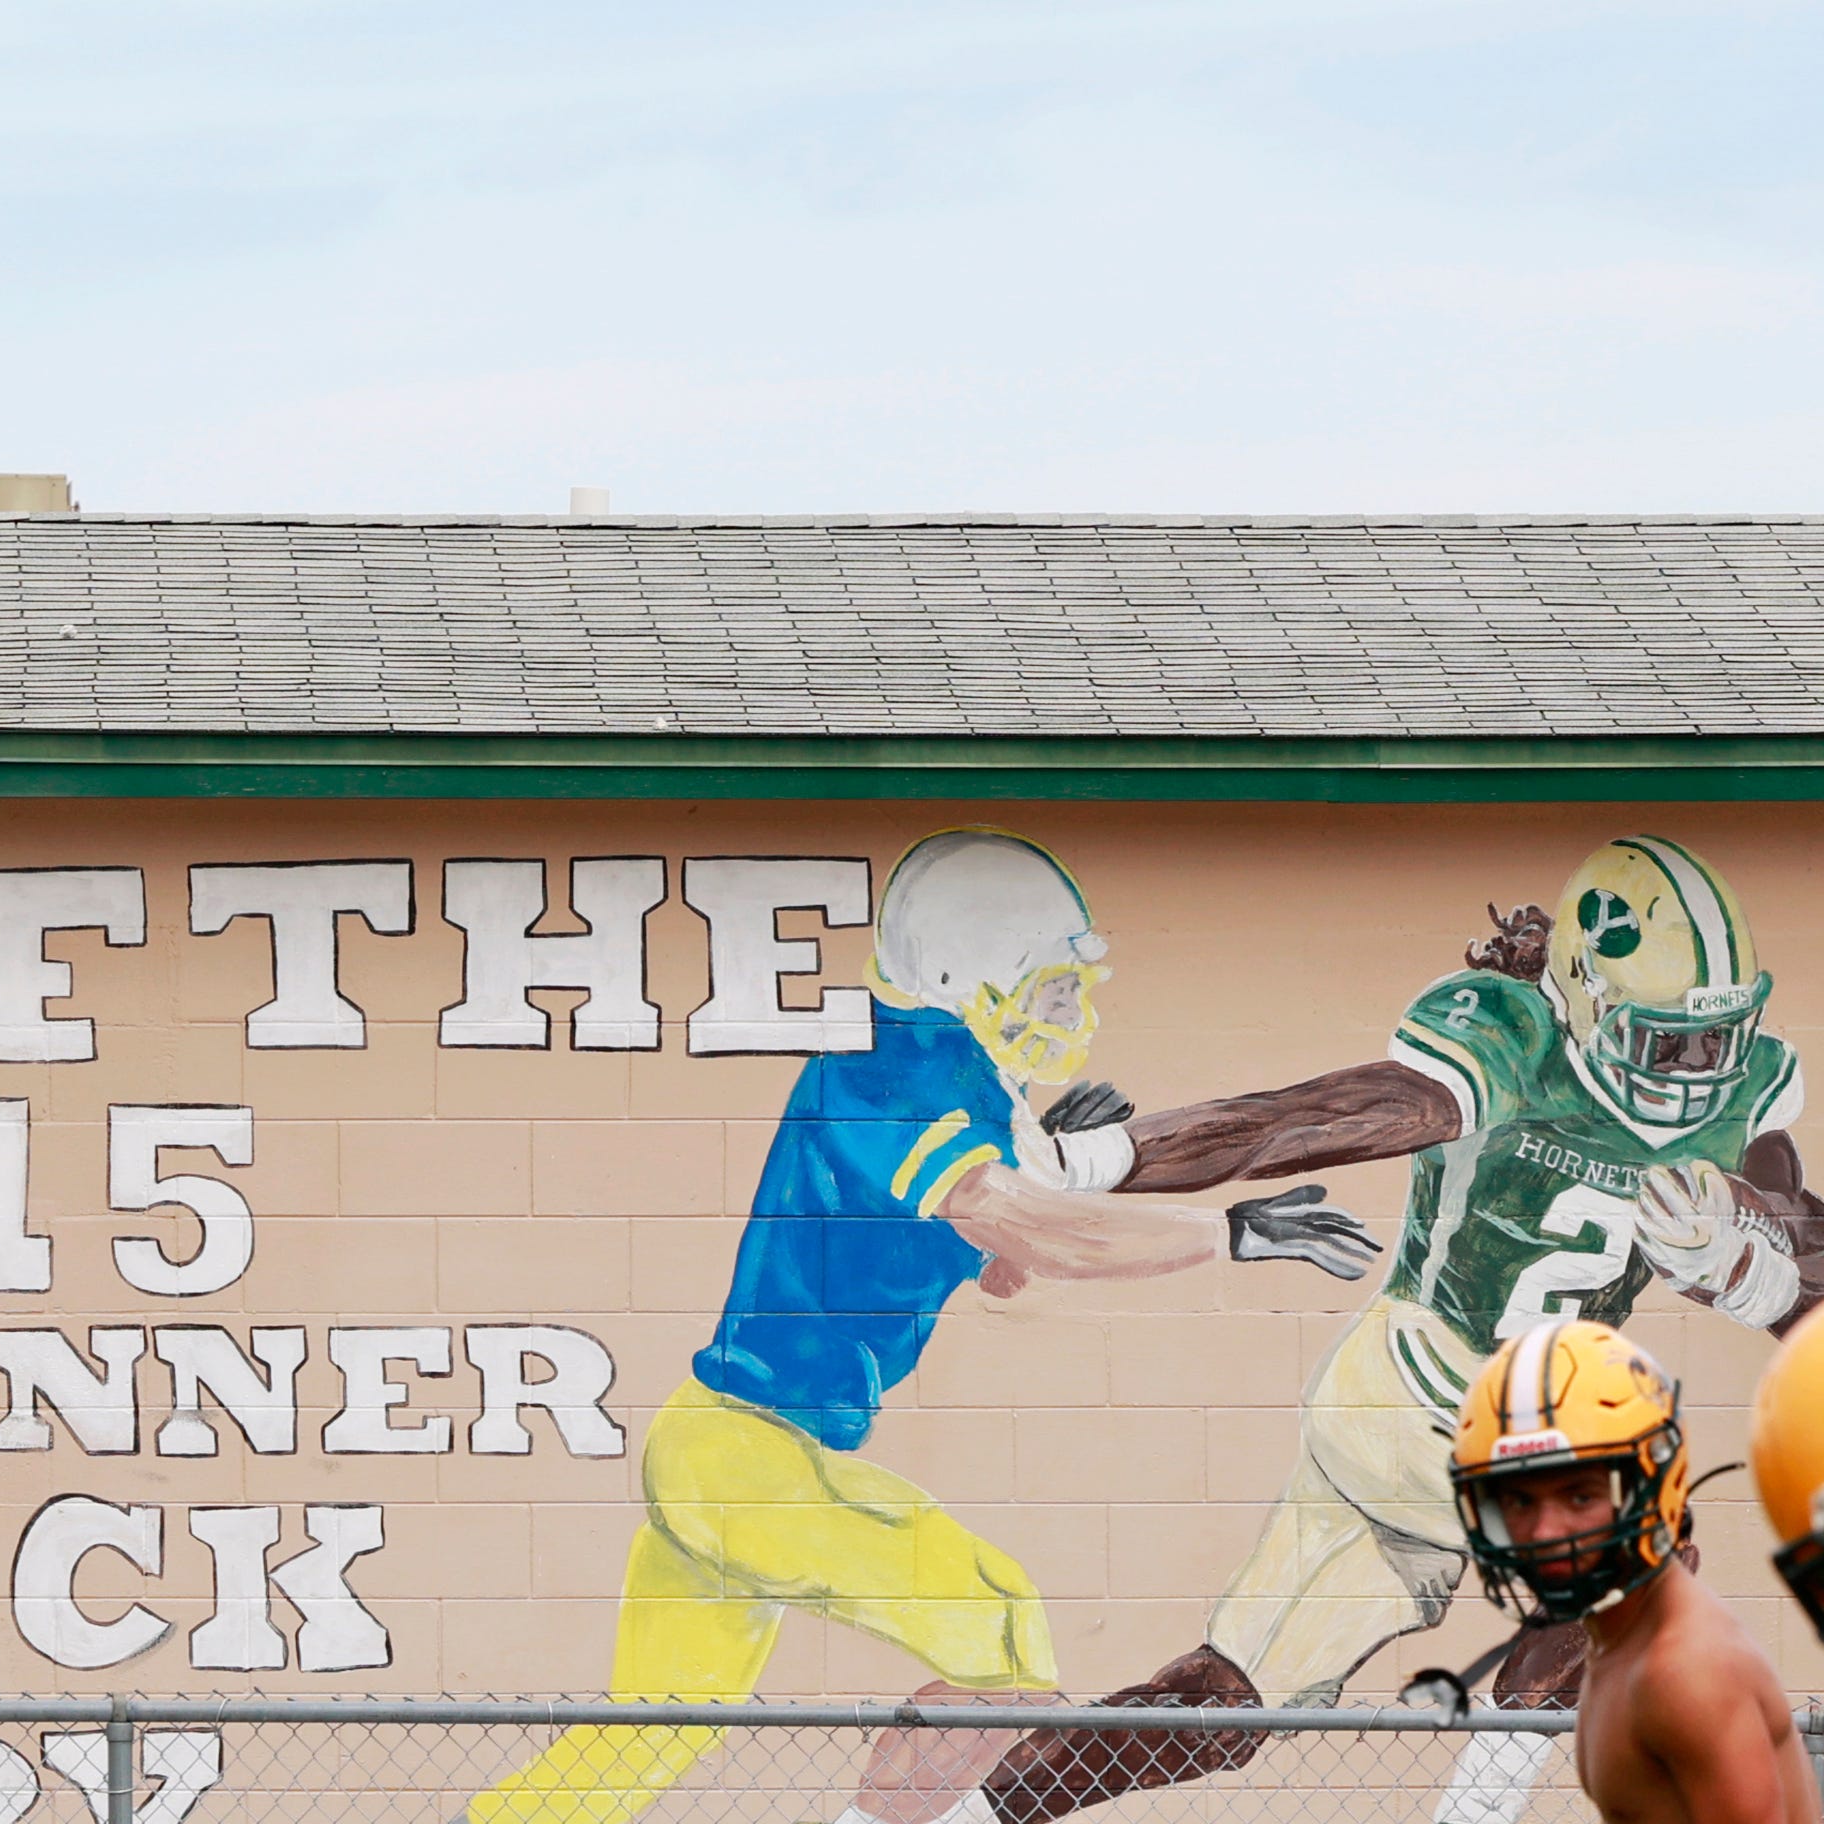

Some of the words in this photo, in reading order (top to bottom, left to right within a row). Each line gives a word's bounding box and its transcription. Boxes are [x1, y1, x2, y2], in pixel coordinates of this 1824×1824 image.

[188, 855, 874, 1057] THE
[1444, 988, 1479, 1032] 2
[1494, 1183, 1636, 1340] 2
